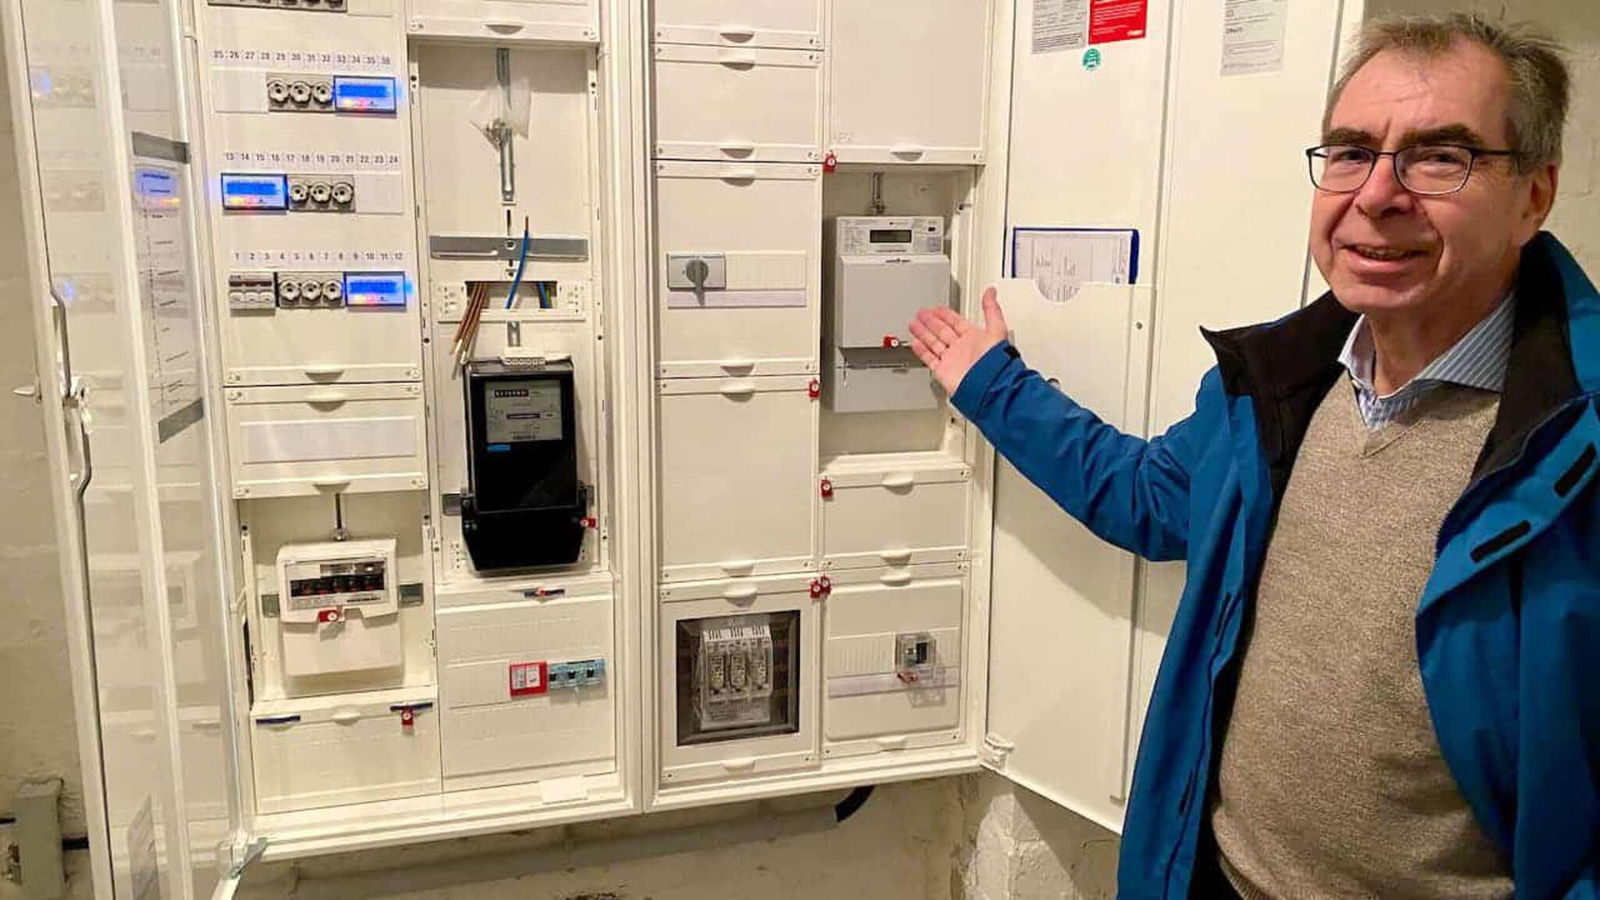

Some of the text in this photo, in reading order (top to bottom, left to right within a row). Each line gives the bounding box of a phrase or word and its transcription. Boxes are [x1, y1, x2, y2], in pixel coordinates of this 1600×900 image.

[229, 50, 240, 59] 26
[245, 51, 255, 59] 27
[276, 52, 285, 60] 29
[291, 52, 301, 61] 30
[307, 54, 315, 63] 31
[322, 54, 331, 62] 32
[337, 54, 346, 64] 33
[351, 55, 361, 64] 34
[366, 56, 376, 64] 35
[226, 153, 234, 161] 13
[241, 153, 249, 161] 14
[256, 153, 265, 161] 15
[271, 153, 280, 161] 16
[301, 154, 310, 162] 18
[316, 154, 325, 163] 19
[330, 155, 340, 163] 20
[346, 155, 354, 163] 21
[360, 155, 369, 163] 22
[374, 155, 384, 163] 23
[389, 155, 398, 163] 24
[366, 252, 375, 261] 10
[380, 252, 388, 260] 11
[395, 252, 403, 260] 12
